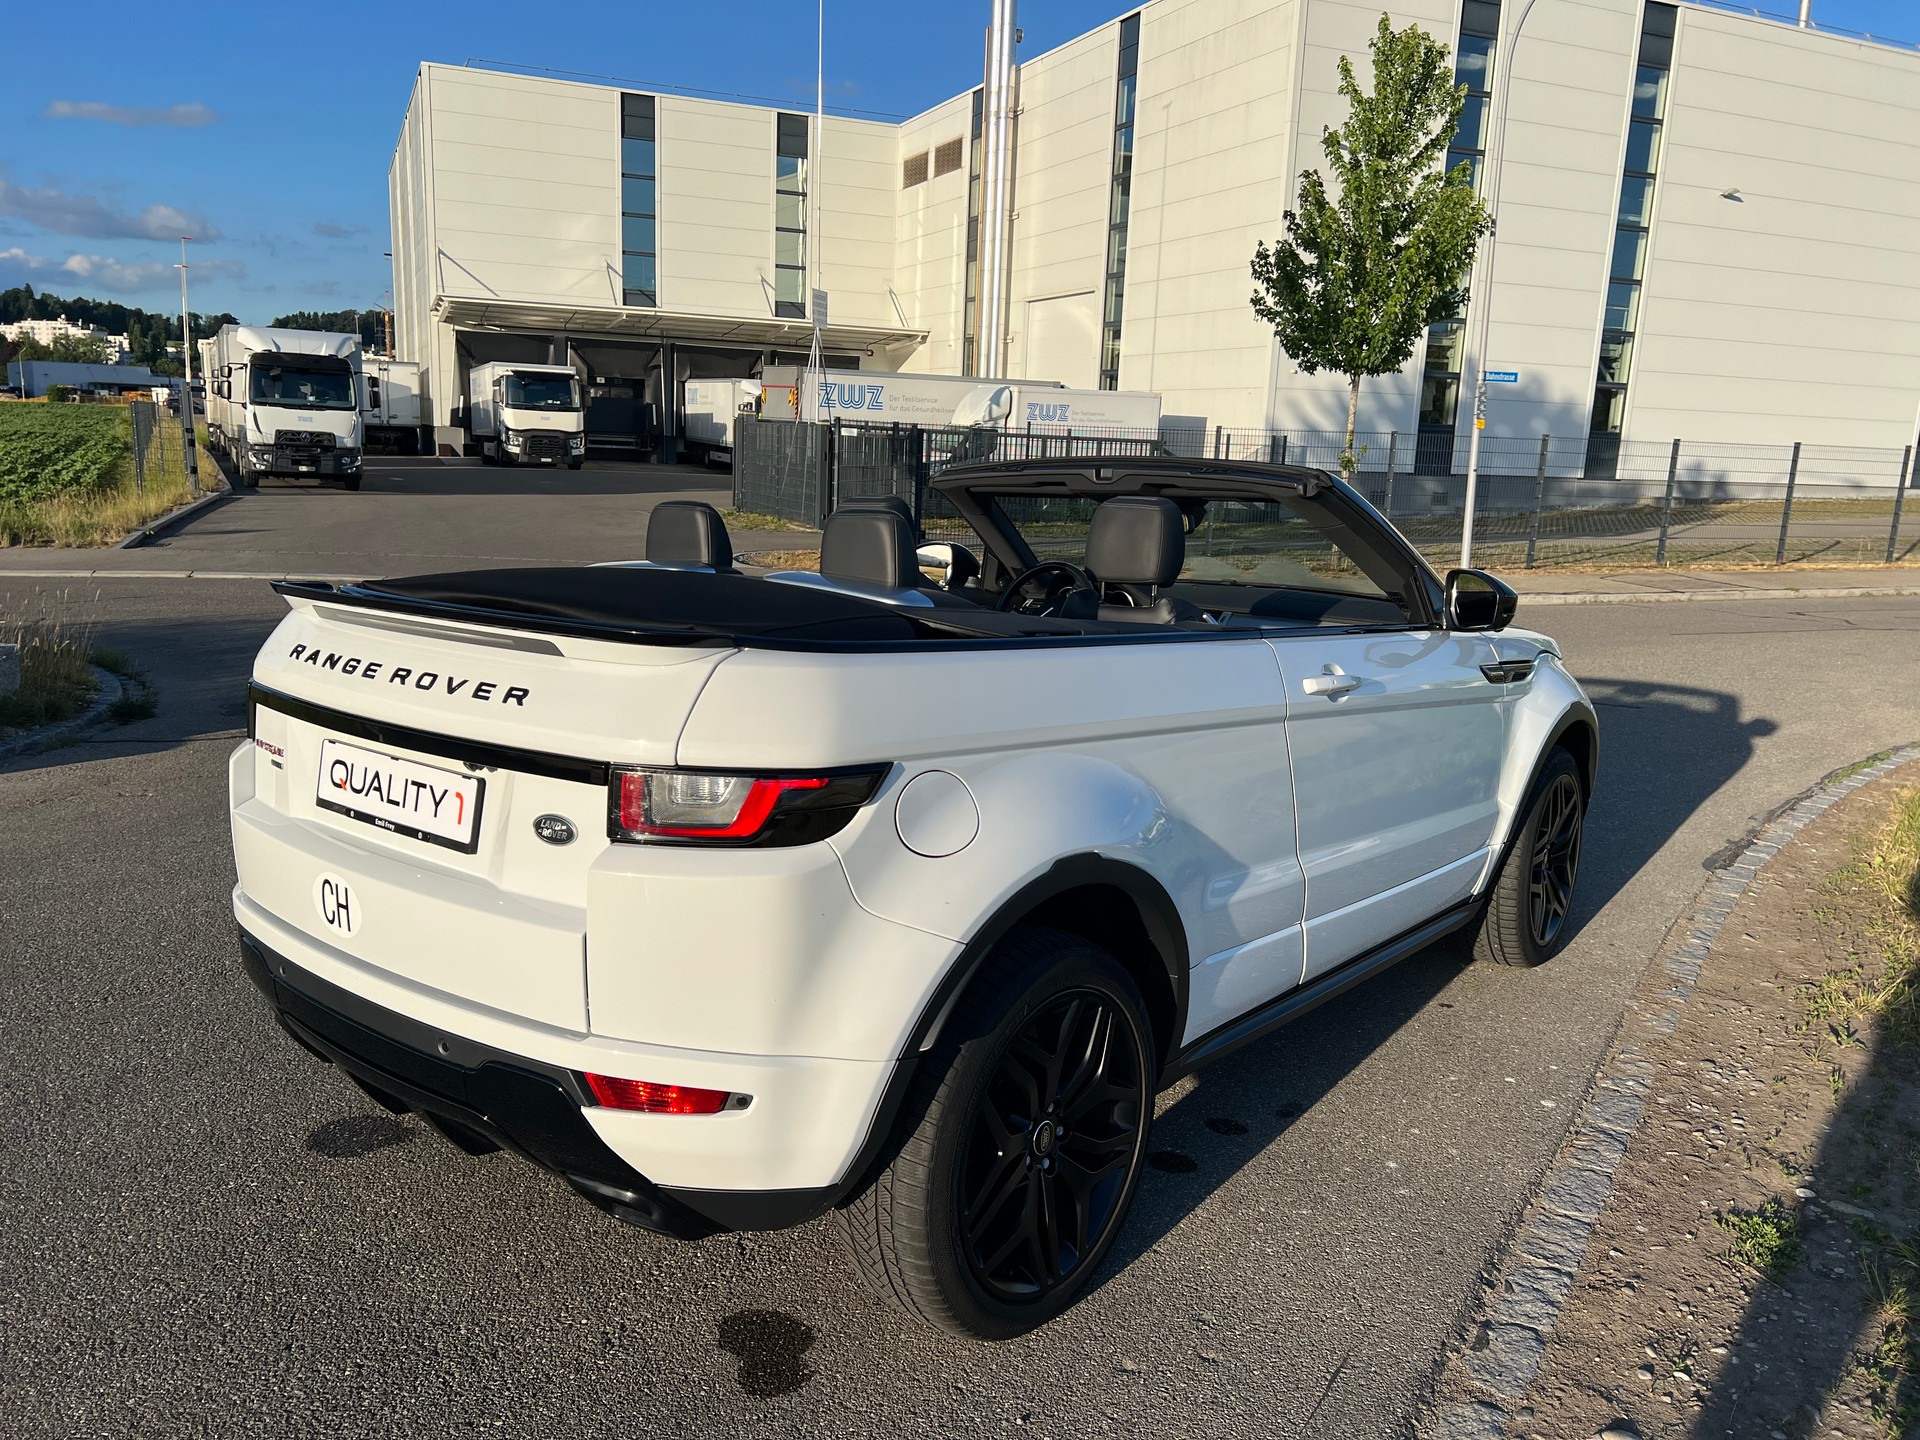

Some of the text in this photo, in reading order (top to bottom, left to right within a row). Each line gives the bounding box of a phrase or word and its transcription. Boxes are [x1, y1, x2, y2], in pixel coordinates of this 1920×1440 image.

[819, 382, 884, 411] ZWZ
[902, 395, 938, 404] Textilservice
[912, 406, 956, 414] Gesundheitswe
[1027, 402, 1070, 422] ZWZ
[288, 643, 530, 707] RANGE ROVER
[375, 818, 395, 831] Emil Frey
[321, 878, 352, 932] CH
